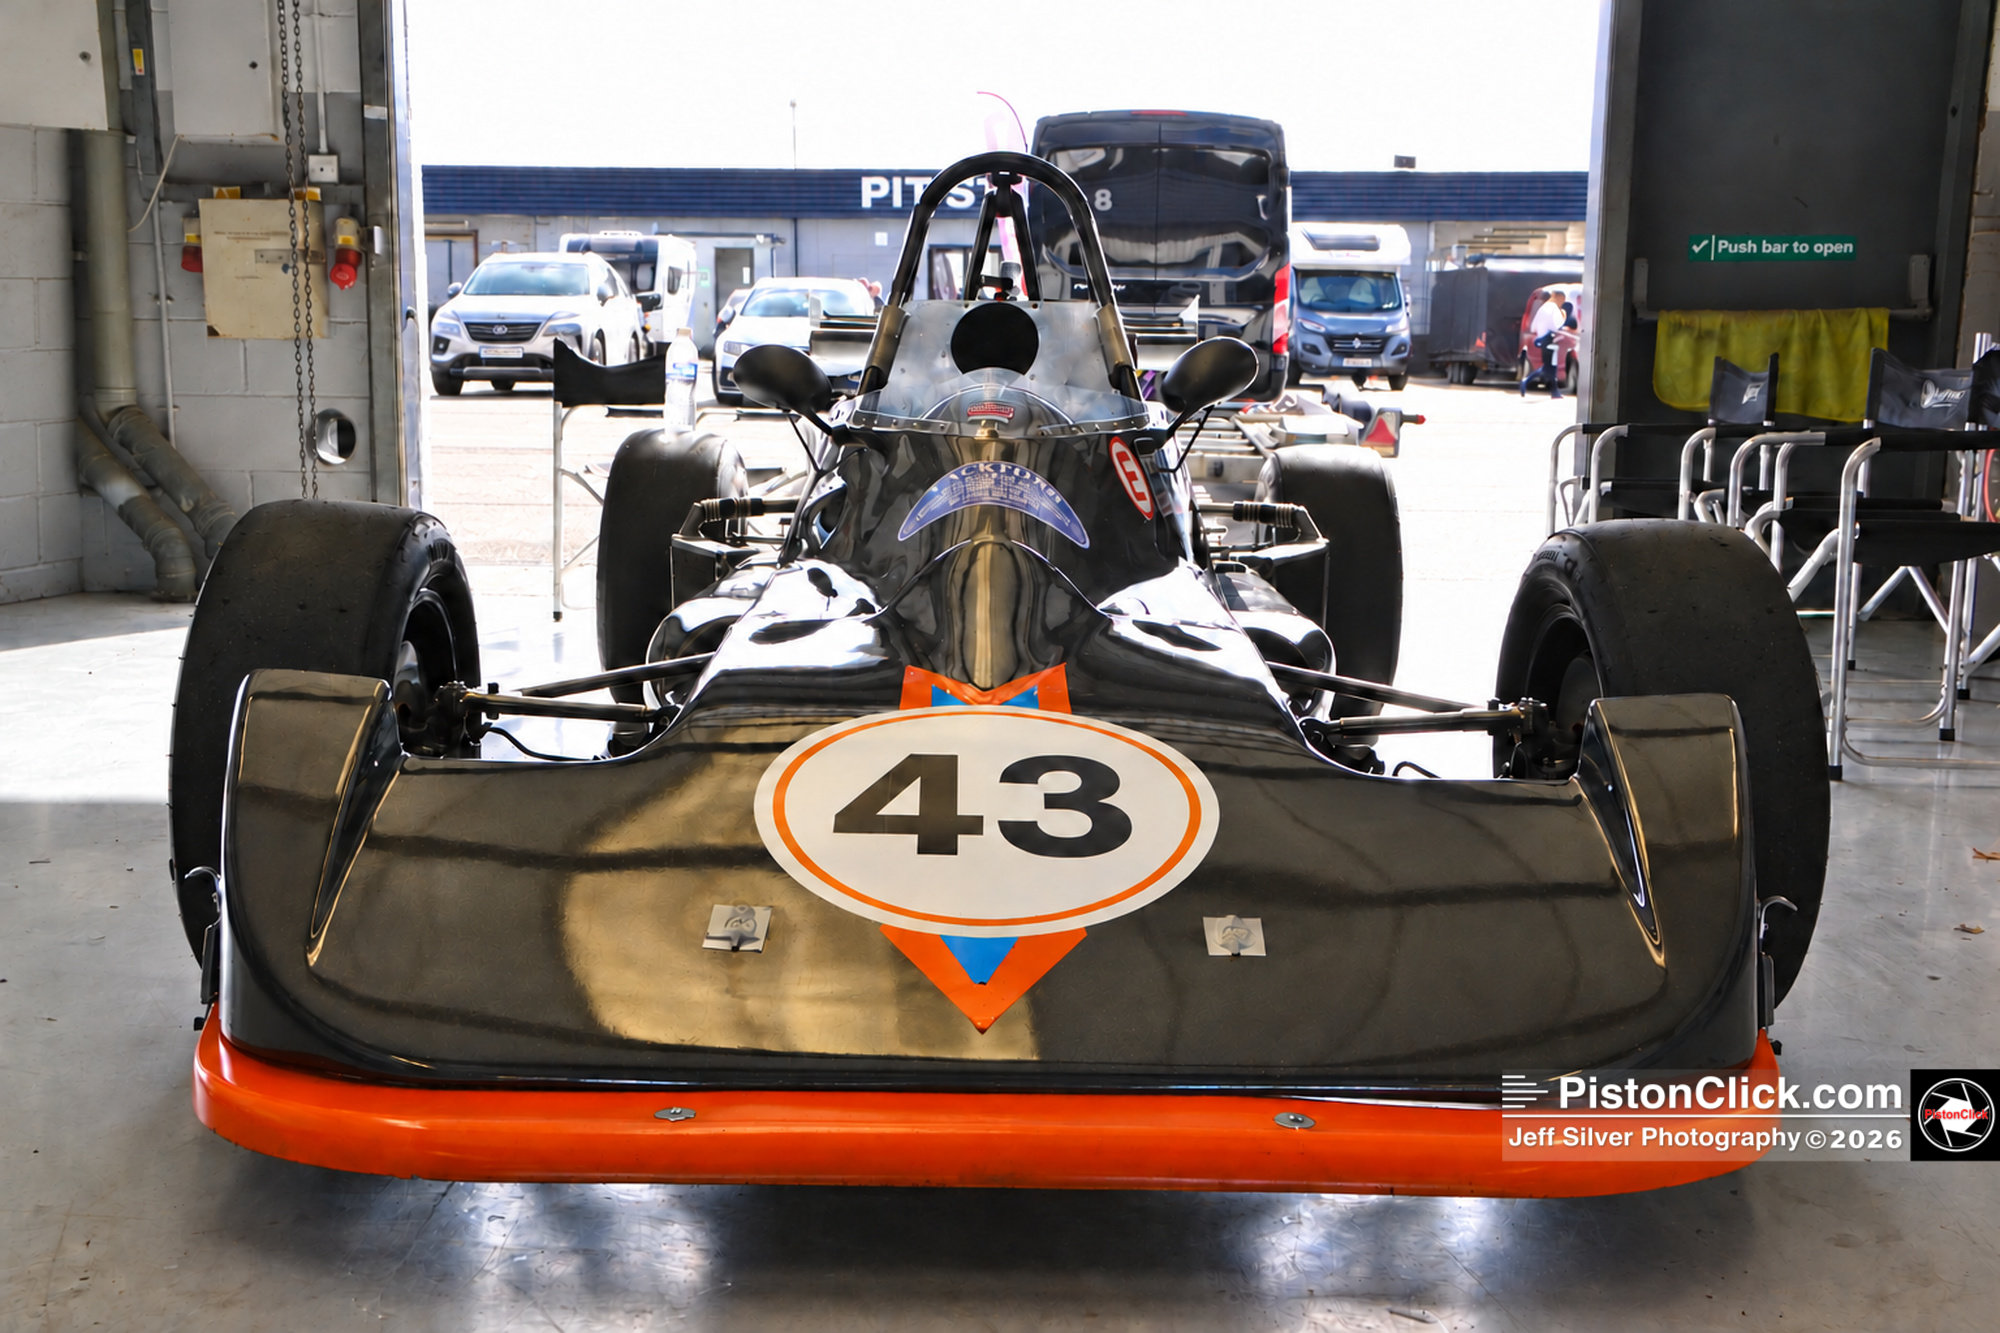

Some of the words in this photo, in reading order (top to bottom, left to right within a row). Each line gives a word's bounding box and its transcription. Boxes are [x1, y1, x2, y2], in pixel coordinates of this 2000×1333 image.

[861, 176, 933, 209] PIT
[1094, 188, 1113, 212] 8
[1718, 240, 1758, 253] Push
[1762, 240, 1790, 253] bar
[1792, 241, 1810, 253] to
[1813, 242, 1854, 257] open
[833, 754, 1133, 858] 43
